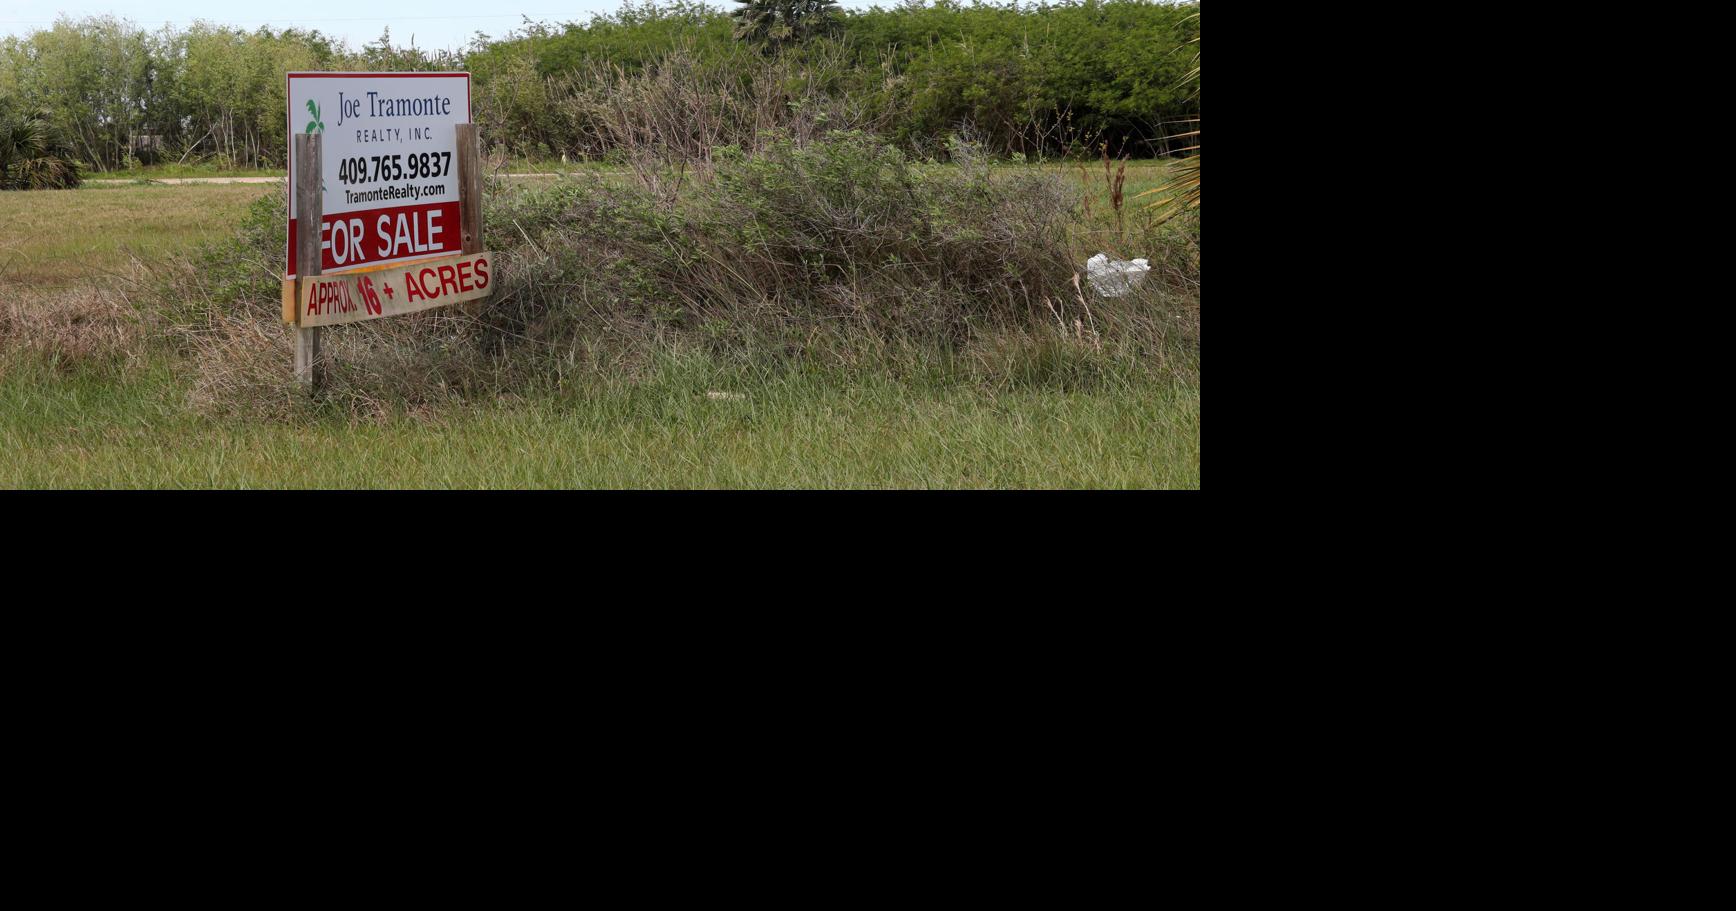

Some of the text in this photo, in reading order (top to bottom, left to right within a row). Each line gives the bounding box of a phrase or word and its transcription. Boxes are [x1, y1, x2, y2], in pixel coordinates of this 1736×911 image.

[338, 91, 451, 126] Joe Tramonte
[356, 126, 433, 144] REALTY, INC.
[338, 151, 452, 185] 409.765.9837
[345, 183, 445, 204] TramonteRealty.com
[376, 209, 443, 258] SALE
[307, 279, 357, 316] APPROX.
[357, 275, 383, 316] 16
[404, 258, 489, 303] ACRES
